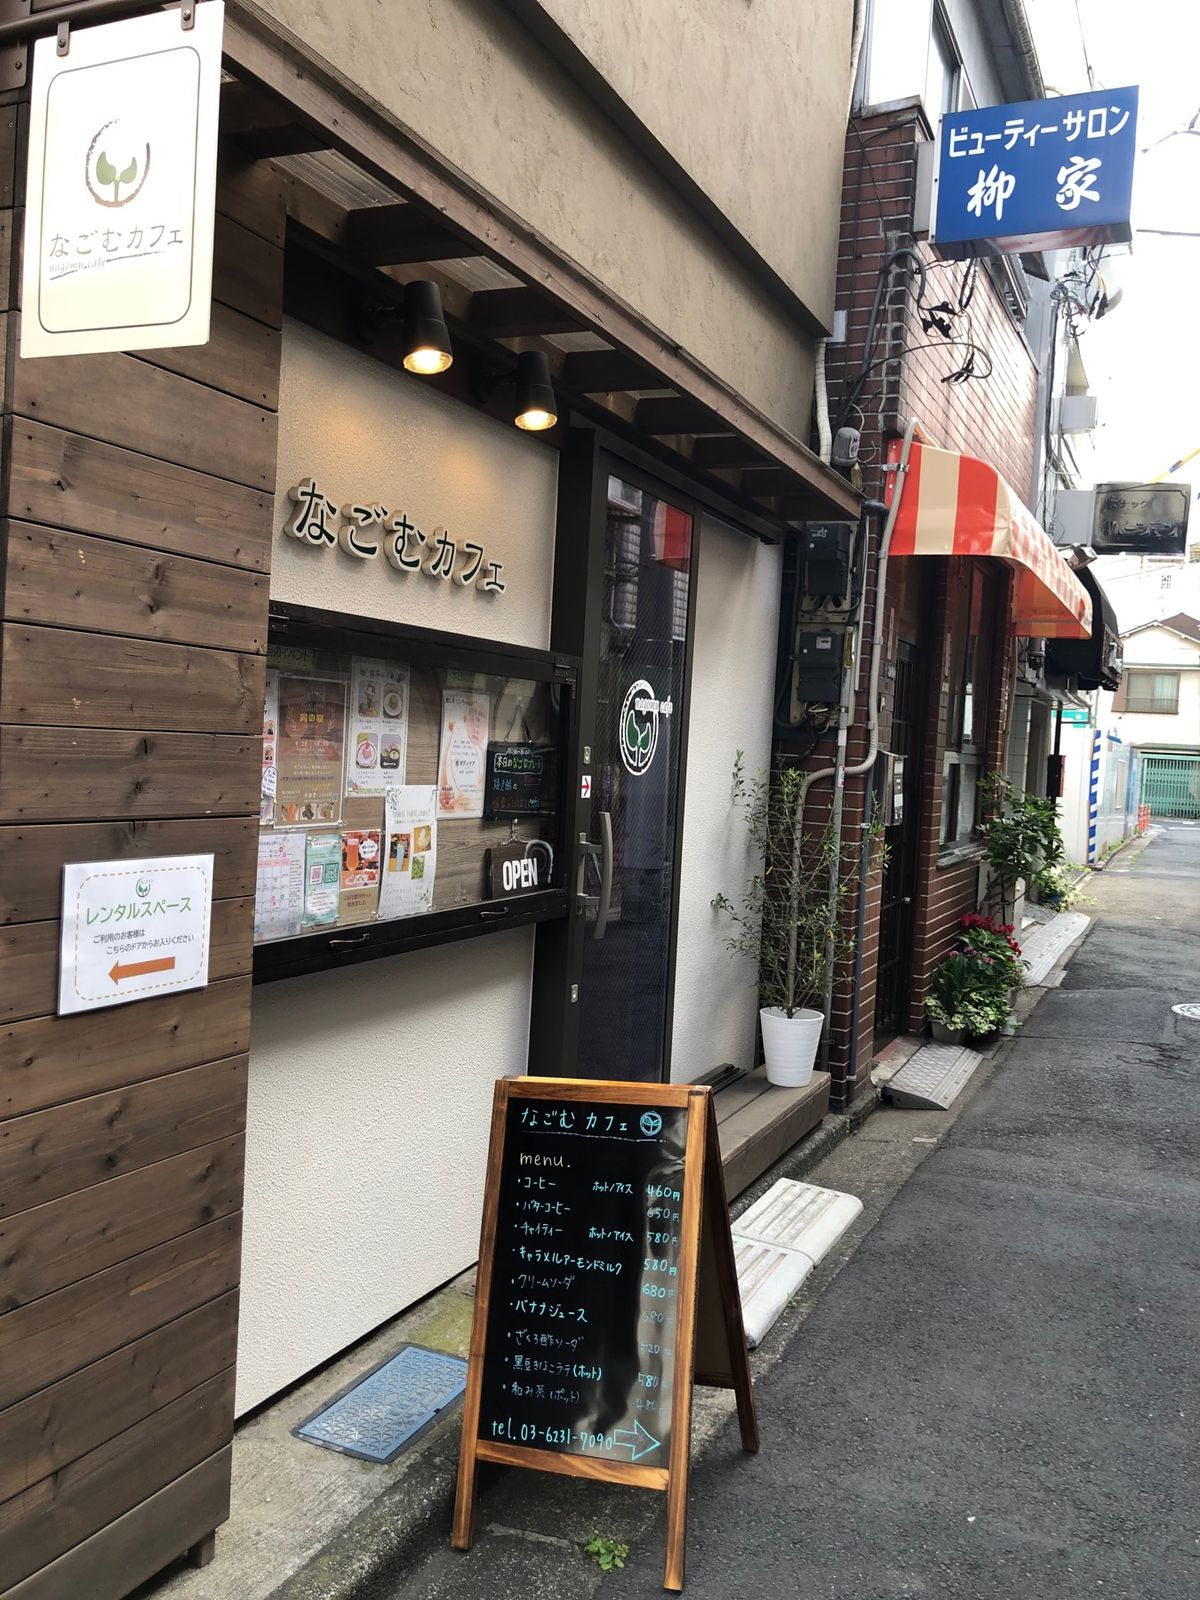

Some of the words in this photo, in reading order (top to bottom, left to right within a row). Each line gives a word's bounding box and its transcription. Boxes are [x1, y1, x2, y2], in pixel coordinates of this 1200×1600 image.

[949, 106, 1130, 158] ビューティーサロン
[49, 225, 184, 258] なごむカフェ
[293, 479, 506, 593] なごむカフェ
[502, 857, 538, 891] OPEN
[86, 897, 192, 926] レンタルスペース
[93, 929, 145, 944] ご利用のお客様は
[106, 935, 194, 955] こちらのドアからお入りください
[519, 1152, 571, 1168] menu.
[646, 1185, 680, 1201] 460円
[643, 1259, 678, 1275] 580円
